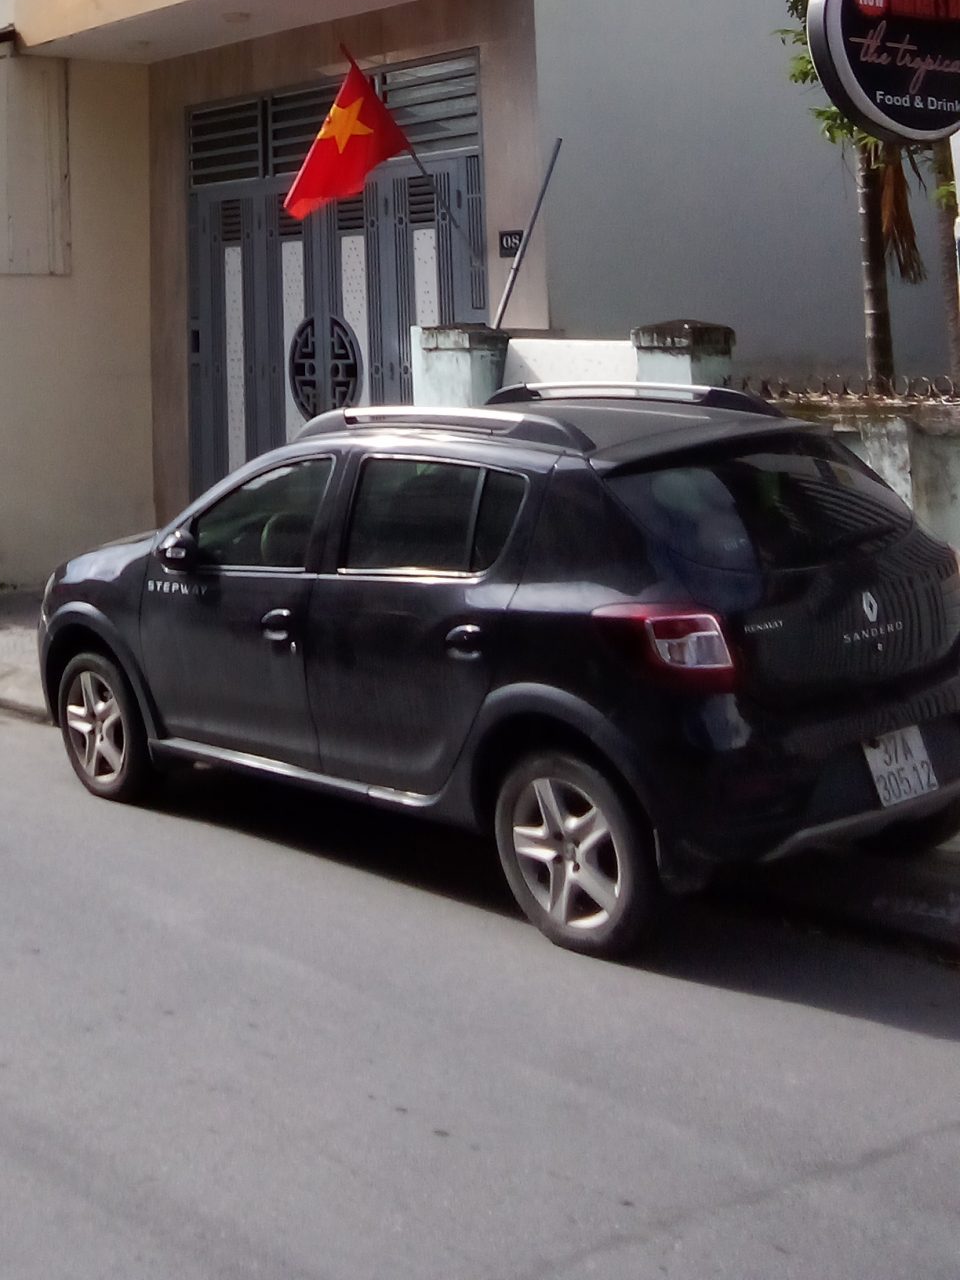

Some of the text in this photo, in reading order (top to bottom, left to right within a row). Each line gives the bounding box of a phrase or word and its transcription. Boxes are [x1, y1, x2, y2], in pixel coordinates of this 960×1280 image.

[848, 19, 892, 65] the
[875, 90, 911, 107] Food
[914, 95, 924, 108] &
[147, 579, 208, 595] STEPWAY
[843, 621, 903, 643] SANDERO
